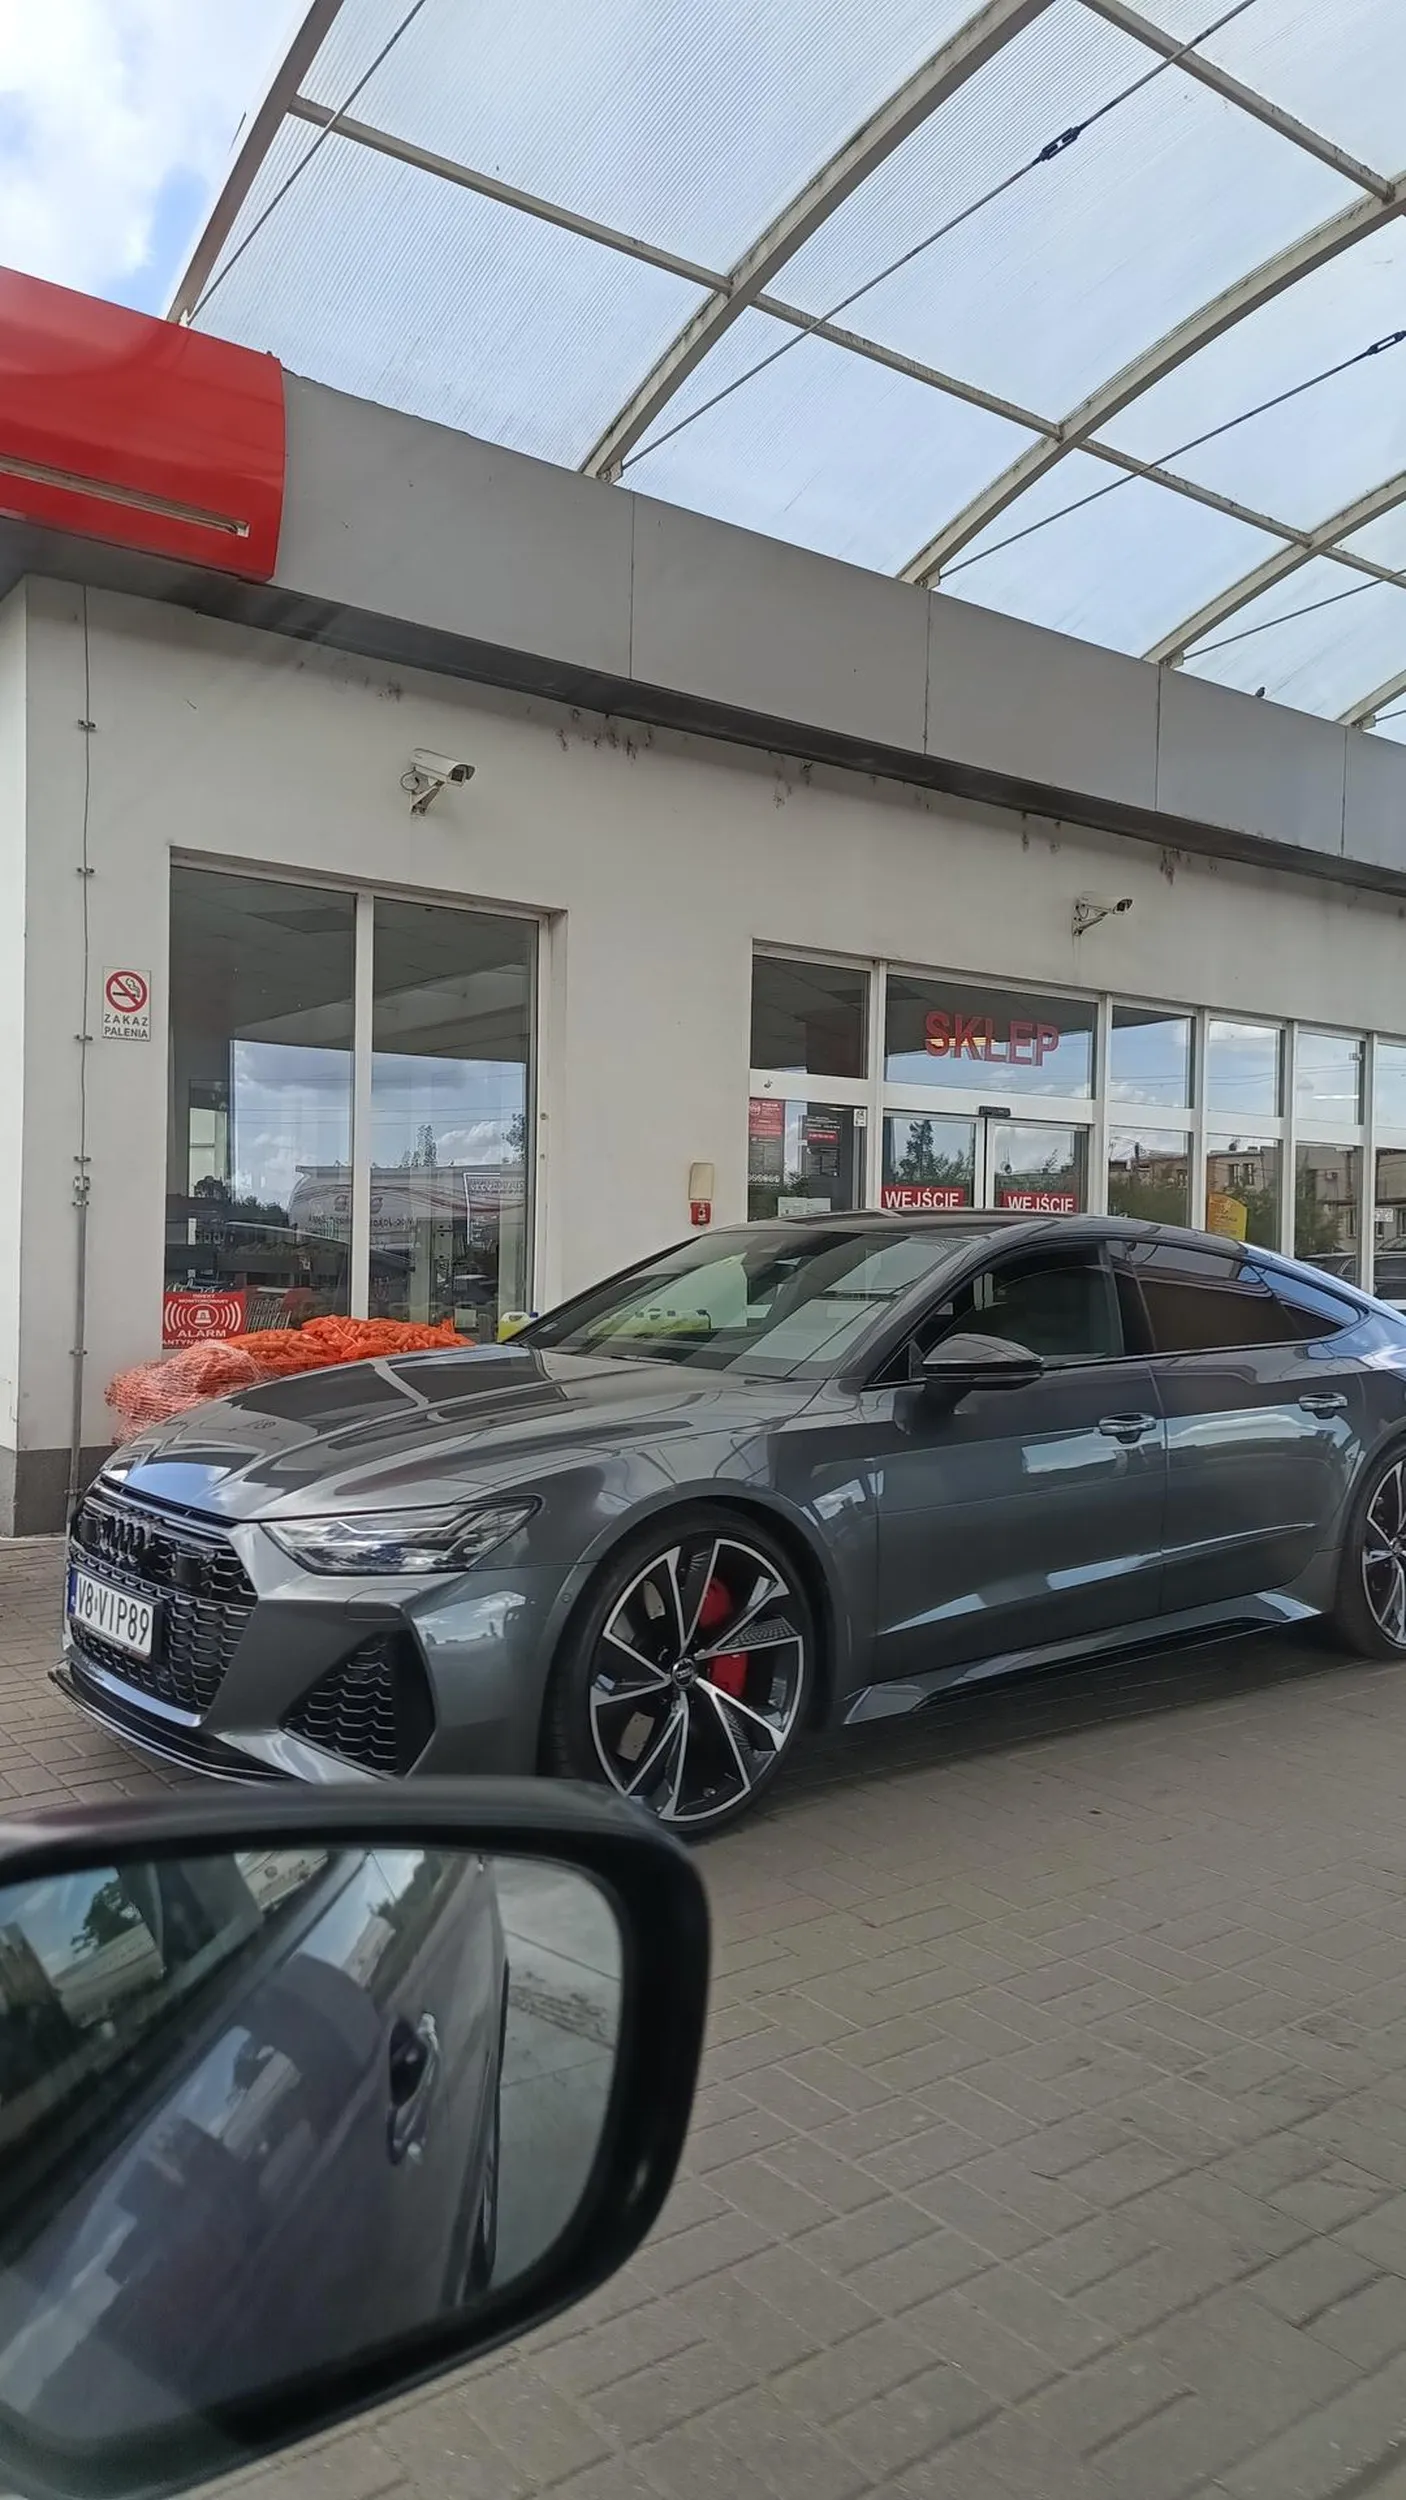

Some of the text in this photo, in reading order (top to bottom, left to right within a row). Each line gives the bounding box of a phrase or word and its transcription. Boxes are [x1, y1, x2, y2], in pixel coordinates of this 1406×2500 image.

[104, 1014, 148, 1027] ZAKAZ
[104, 1026, 147, 1038] PALENIA
[925, 1009, 1060, 1067] SKLEP
[885, 1187, 960, 1208] WEJŚCIE
[1007, 1193, 1074, 1213] WEJŚCIE
[177, 1330, 226, 1338] ALARM
[78, 1576, 150, 1646] V8 VIP89
